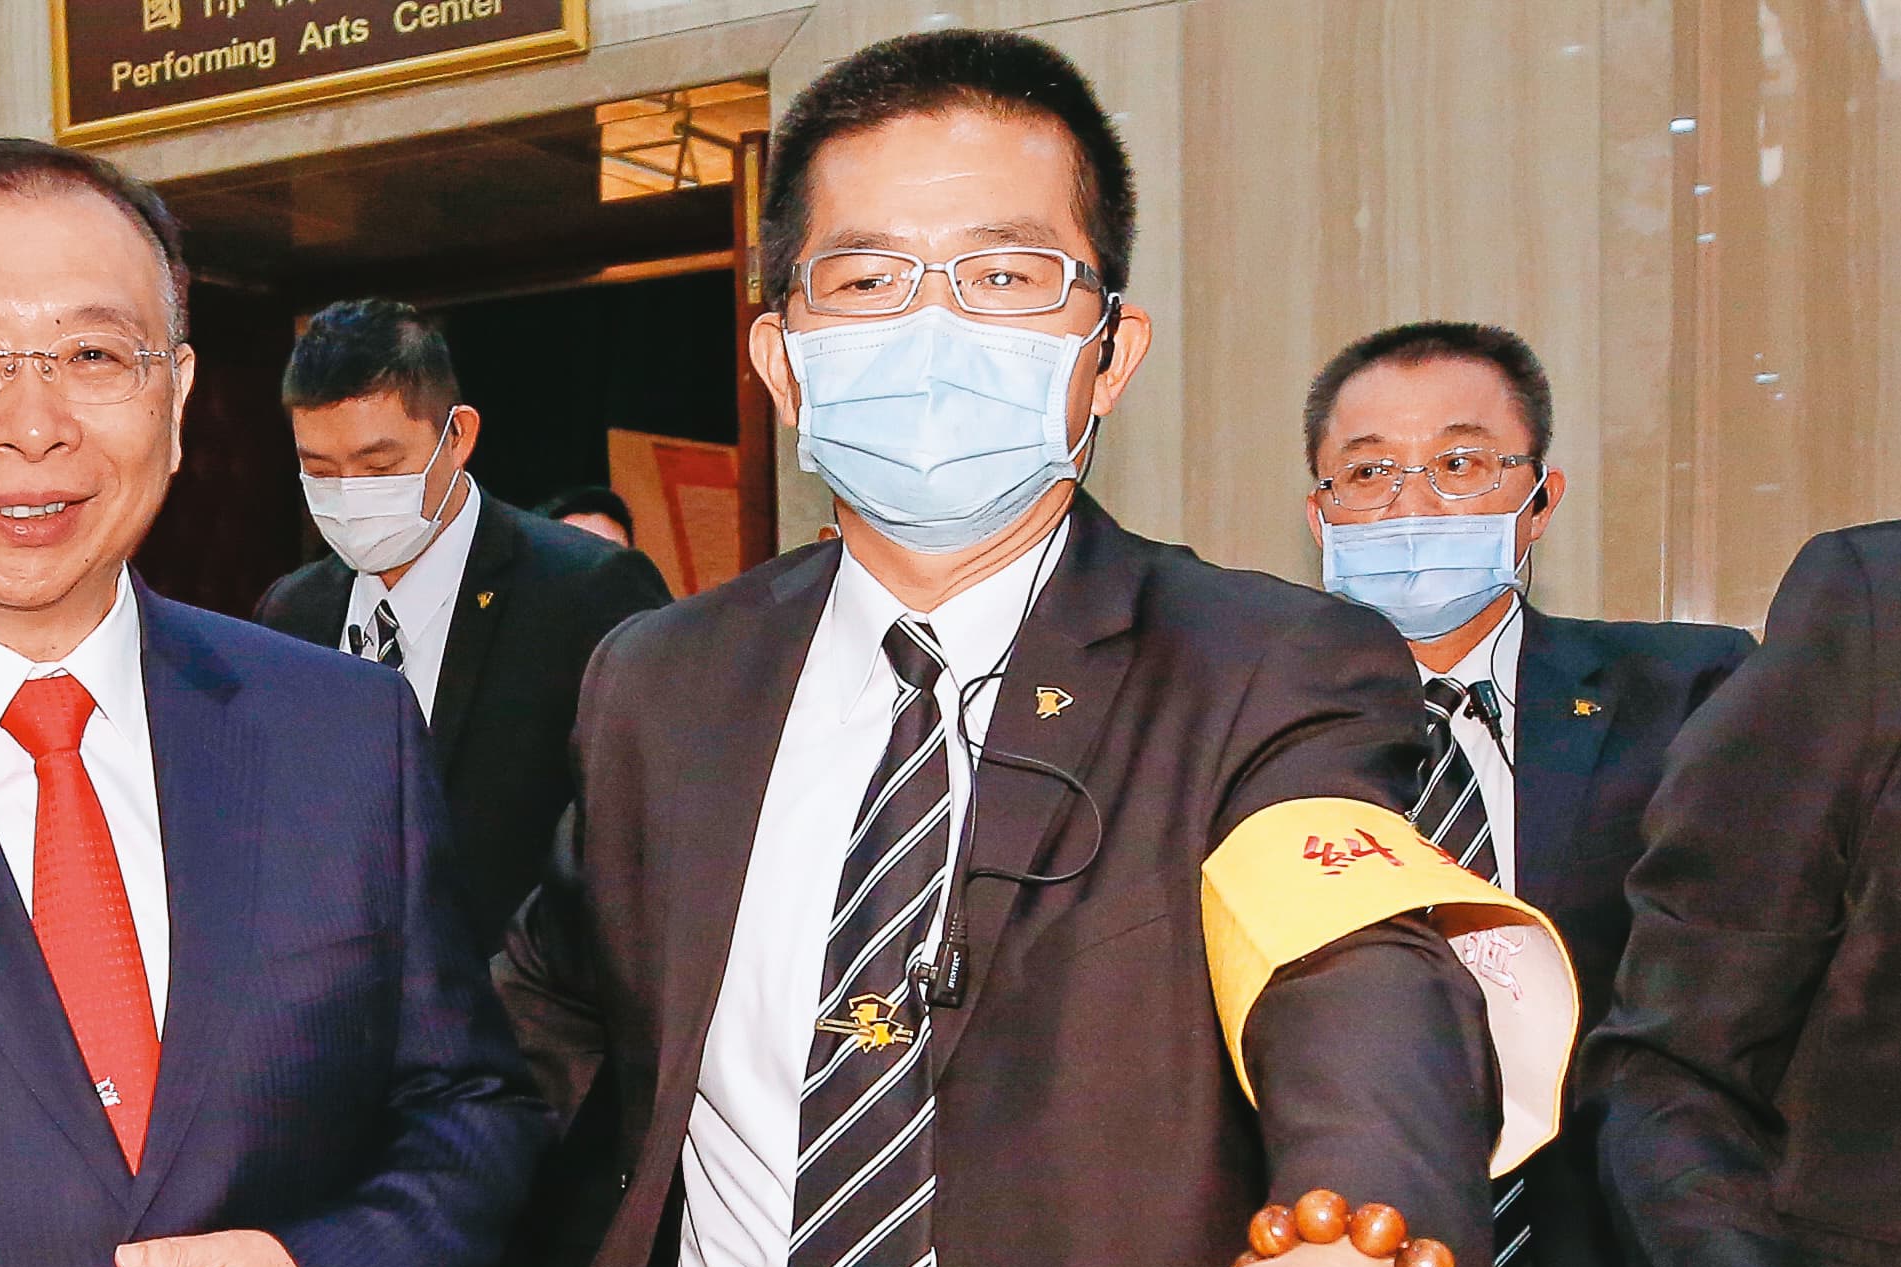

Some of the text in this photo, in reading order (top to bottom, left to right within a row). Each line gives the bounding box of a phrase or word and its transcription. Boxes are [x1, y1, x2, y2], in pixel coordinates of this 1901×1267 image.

[111, 36, 277, 93] Performing
[297, 15, 371, 55] Arts
[392, 0, 502, 33] Center
